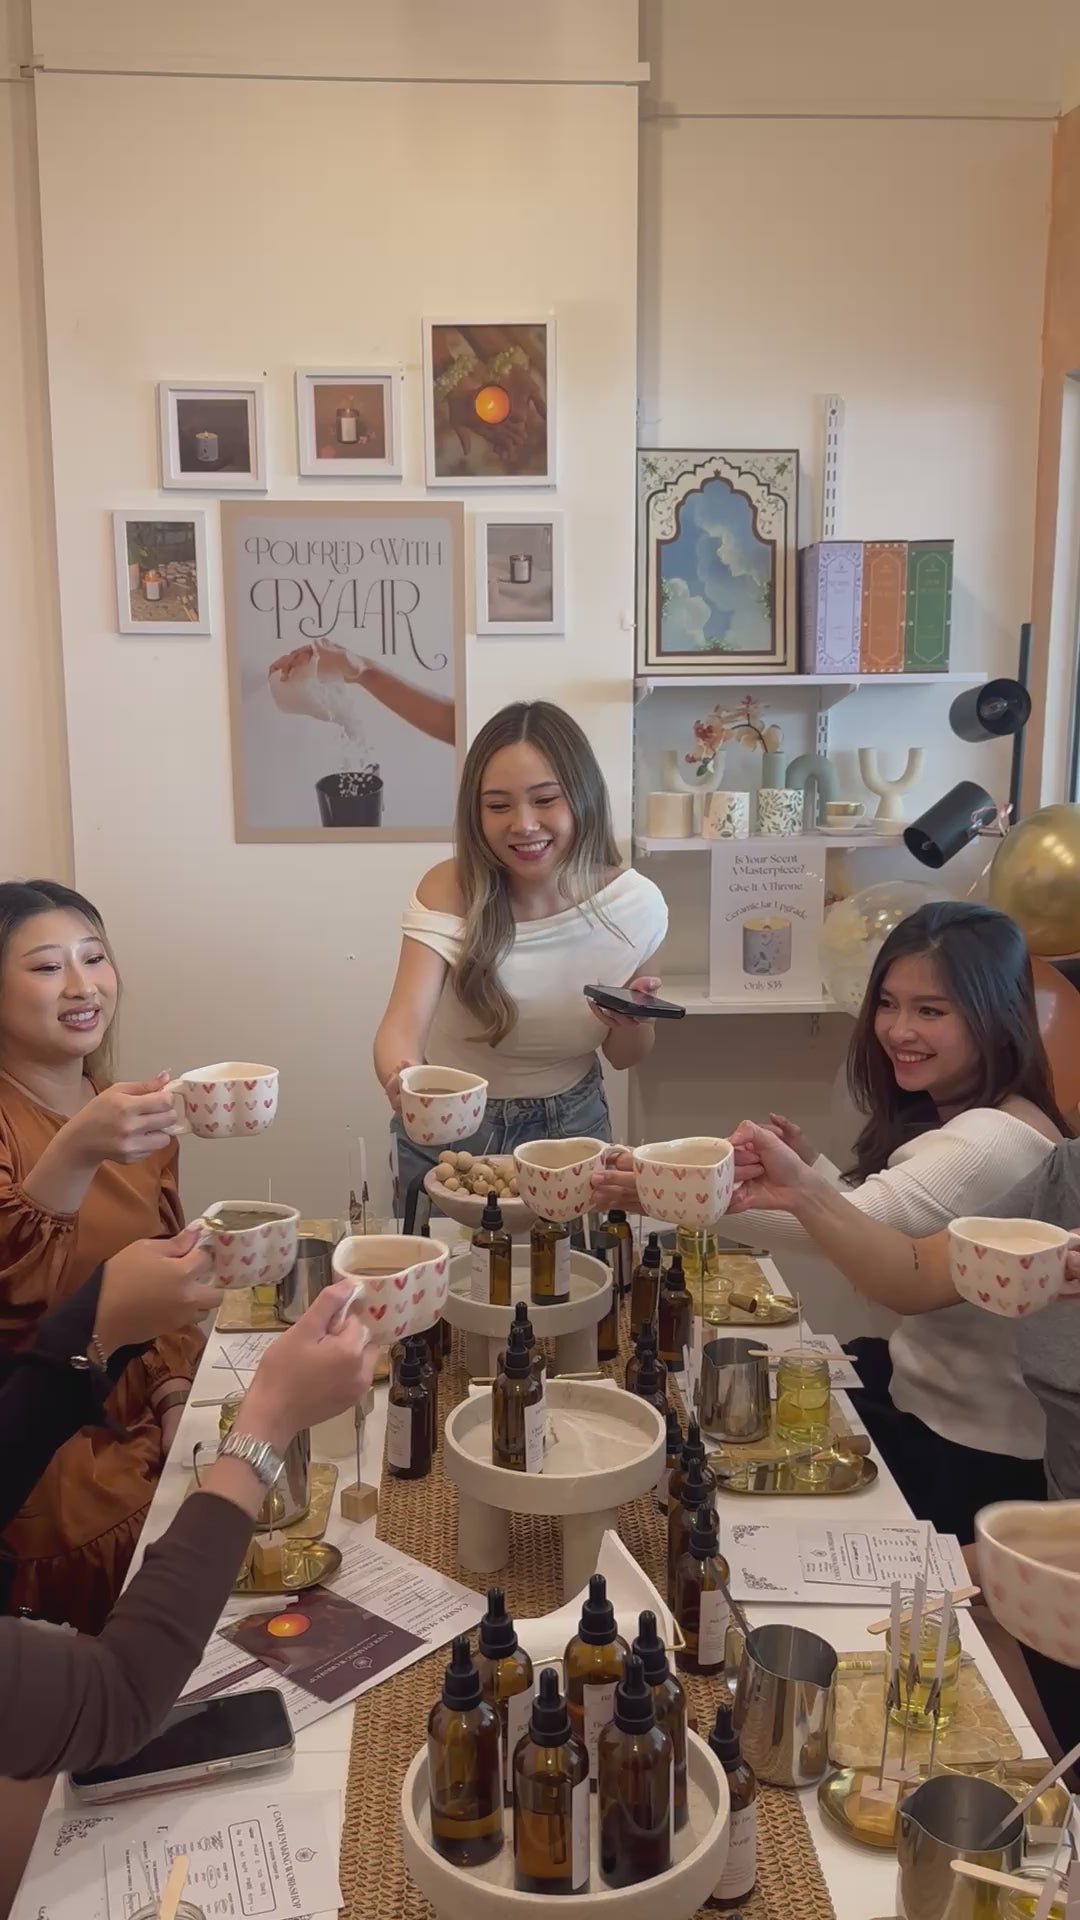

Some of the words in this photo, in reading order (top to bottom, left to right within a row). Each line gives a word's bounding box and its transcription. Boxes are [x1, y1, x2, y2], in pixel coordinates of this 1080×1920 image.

[244, 536, 364, 575] POURED
[370, 536, 442, 566] WITH
[250, 578, 448, 672] PYAAR
[735, 855, 743, 865] Is
[745, 855, 768, 865] Your
[769, 853, 798, 864] Scent
[732, 866, 738, 876] A
[740, 864, 804, 877] Masterpiece?
[728, 883, 749, 893] Give
[751, 882, 758, 892] It
[762, 882, 768, 892] A
[724, 902, 760, 922] Ceramic
[760, 900, 772, 909] Jar
[774, 900, 808, 921] Upgrade
[743, 981, 765, 991] Only
[272, 1810, 291, 1866] CANDLEMAKING
[285, 1865, 302, 1910] WORKSHOP
